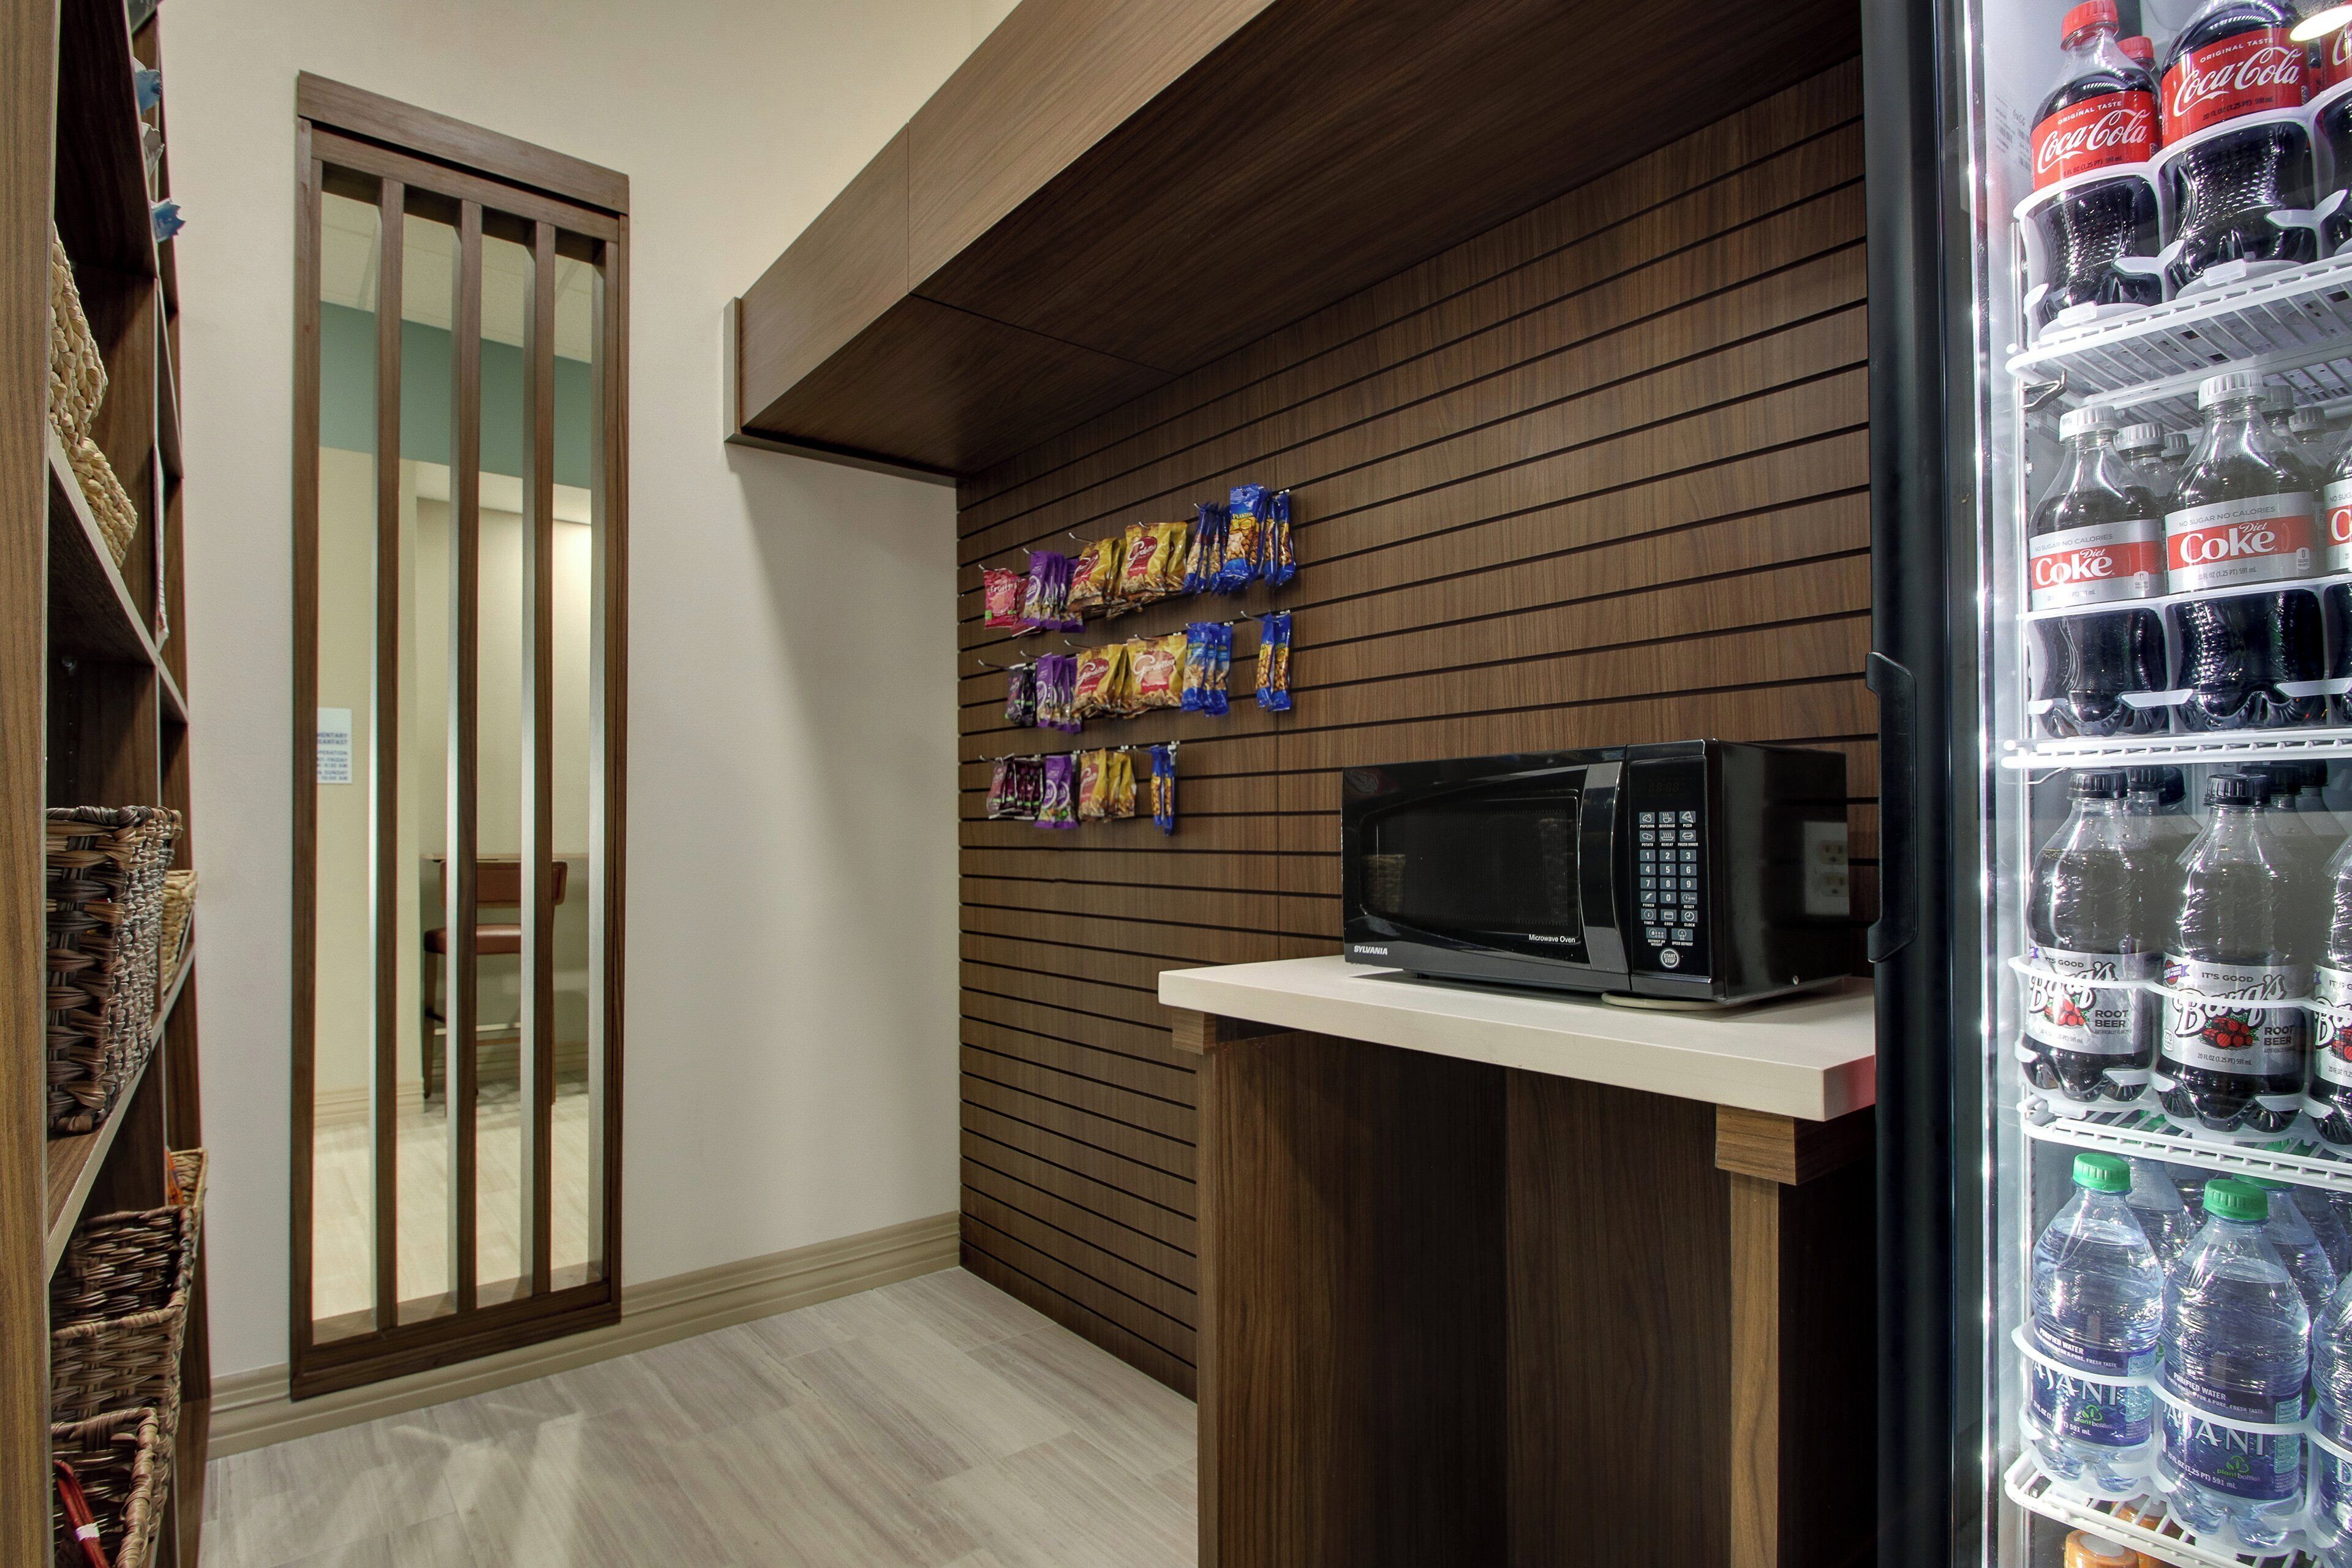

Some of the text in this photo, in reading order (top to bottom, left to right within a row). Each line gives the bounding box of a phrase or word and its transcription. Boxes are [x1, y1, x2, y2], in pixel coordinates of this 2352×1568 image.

[2200, 37, 2274, 62] ORIGINAL TASTE
[2173, 47, 2303, 117] Coca-Cola
[2057, 101, 2122, 125] ORIGINAL TASTE
[2037, 109, 2150, 174] Coca-Cola
[2338, 492, 2352, 501] SUG
[2190, 515, 2215, 525] SUGAR
[2233, 506, 2276, 518] CALORIES
[2239, 522, 2268, 533] Diet
[2041, 543, 2060, 551] SUGAR
[2075, 534, 2113, 544] CALORIES
[2179, 528, 2275, 564] Coke
[2079, 548, 2105, 558] Diet
[2035, 553, 2113, 586] Coke
[2216, 569, 2228, 578] (1.25
[1354, 945, 1388, 956] SYLVANIA
[2058, 958, 2084, 968] GOOD
[2222, 974, 2254, 983] GOOD
[2329, 980, 2345, 989] IT'S
[2095, 1009, 2128, 1018] ROOT
[2095, 1019, 2126, 1028] BEER
[2264, 1025, 2294, 1035] ROOT
[2264, 1036, 2291, 1046] BEER
[2062, 1341, 2084, 1354] WATER
[2086, 1358, 2102, 1366] FRESH
[2174, 1372, 2200, 1391] PURIFIED
[2201, 1386, 2226, 1401] WATER
[2070, 1423, 2080, 1433] 591
[2177, 1460, 2185, 1469] OZ
[2185, 1465, 2199, 1476] (1.25
[2200, 1472, 2211, 1481] PT)
[2212, 1477, 2225, 1486] 591
